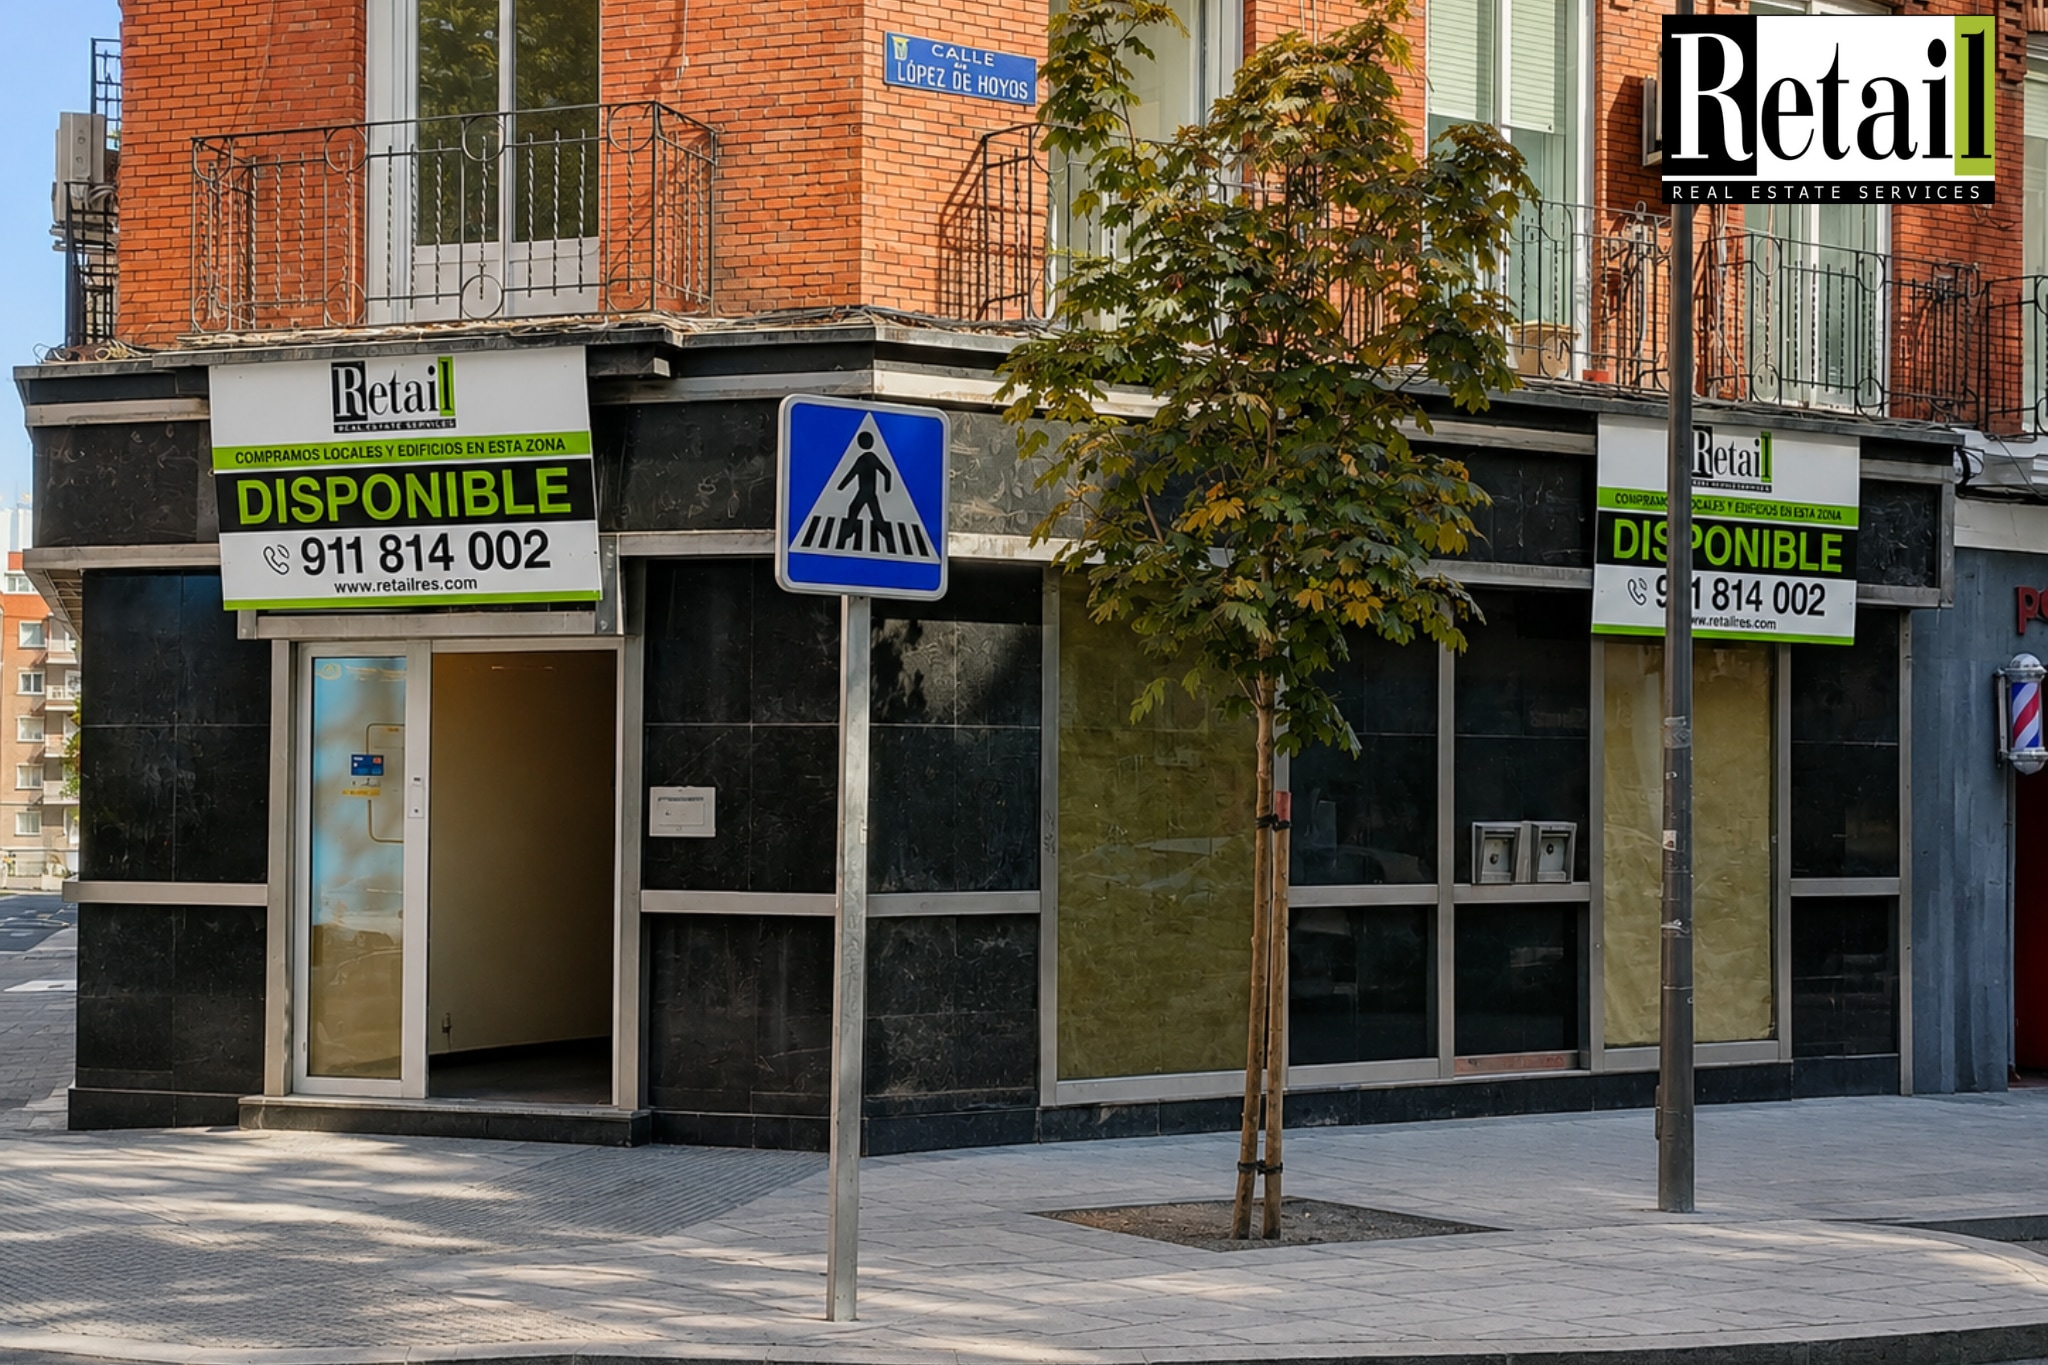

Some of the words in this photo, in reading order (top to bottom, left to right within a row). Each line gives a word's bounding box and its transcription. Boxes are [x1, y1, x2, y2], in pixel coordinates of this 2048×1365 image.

[931, 44, 995, 67] CALLE
[897, 60, 946, 88] LÓPEZ
[952, 70, 972, 92] DE
[978, 75, 1028, 99] HOYOS
[332, 360, 453, 418] Retail
[235, 449, 320, 464] COMPRAMOS
[323, 445, 383, 460] LOCALES
[385, 445, 394, 457] Y
[398, 441, 463, 457] EDIFICIOS
[467, 441, 485, 454] EN
[488, 439, 523, 453] ESTA
[525, 438, 566, 452] ZONA
[1691, 429, 1772, 478] Retail
[236, 467, 572, 525] DISPONIBLE
[1727, 501, 1733, 512] Y
[1794, 507, 1815, 519] ESTA
[1817, 509, 1842, 520] ZONA
[300, 535, 364, 576] 911
[379, 533, 455, 573] 814
[468, 529, 551, 570] 002
[334, 577, 478, 594] www.retailres.com
[1656, 574, 1701, 610] 91
[1712, 577, 1763, 612] 814
[1773, 581, 1826, 617] 002
